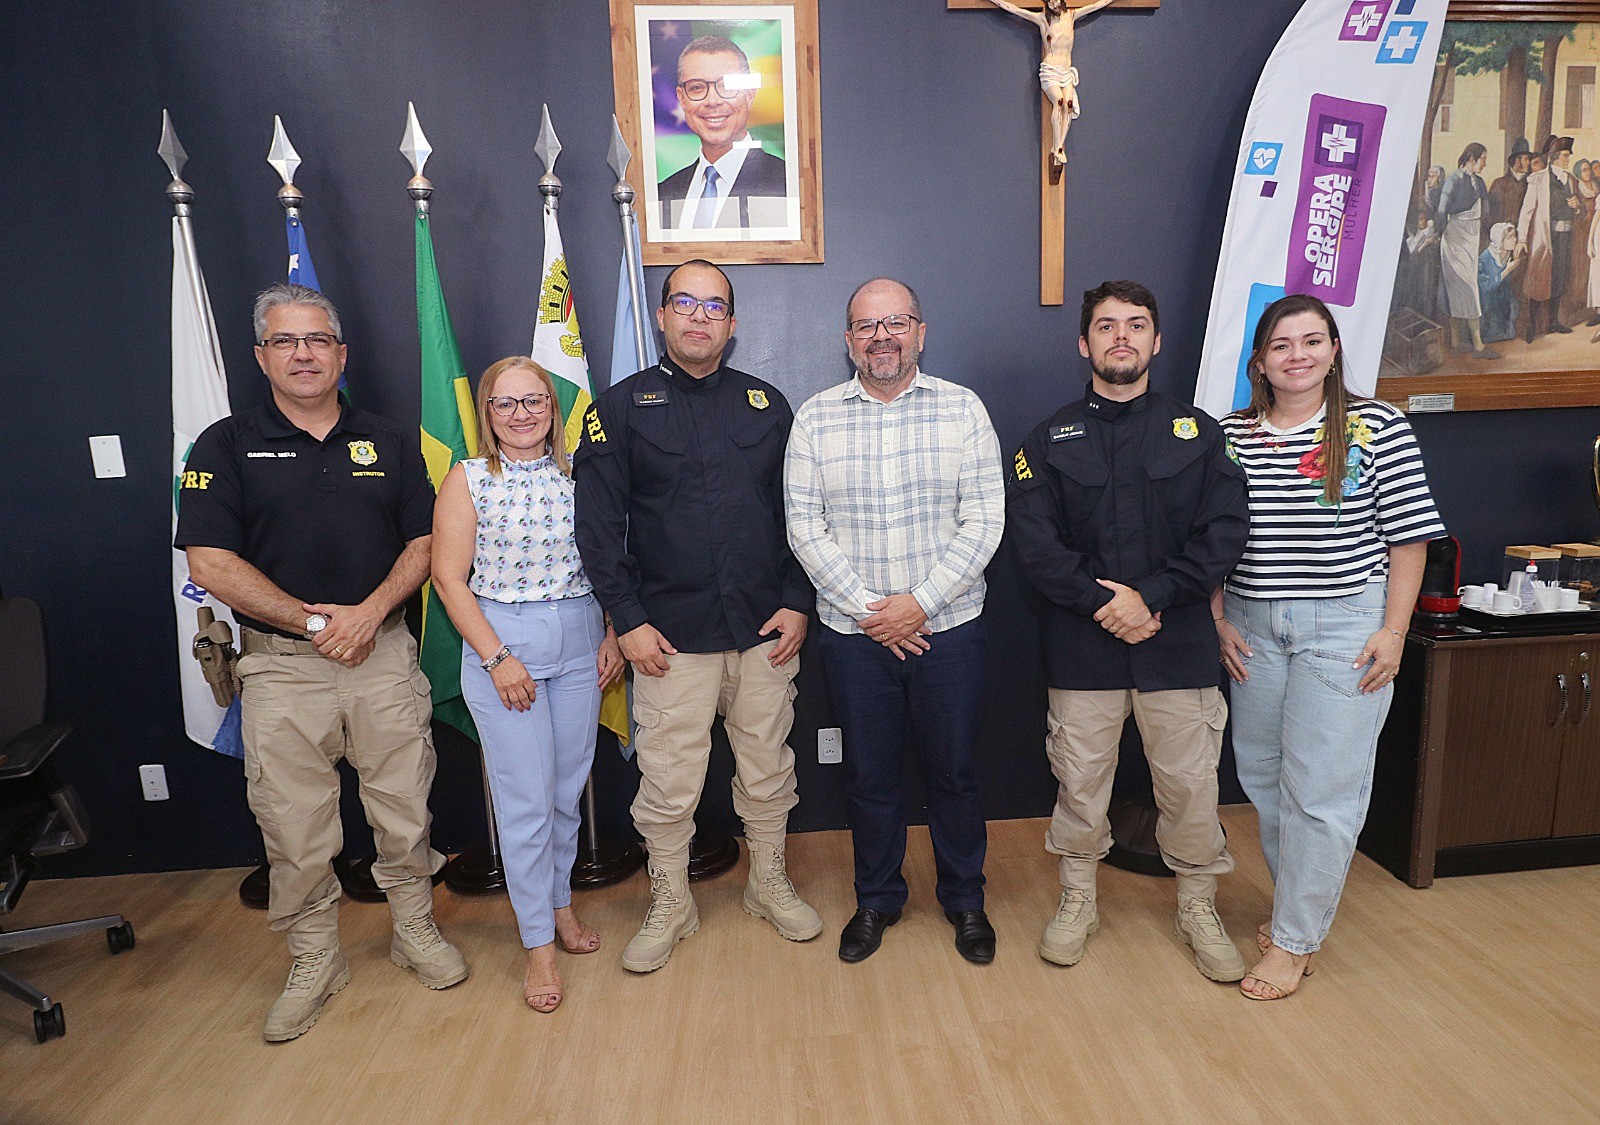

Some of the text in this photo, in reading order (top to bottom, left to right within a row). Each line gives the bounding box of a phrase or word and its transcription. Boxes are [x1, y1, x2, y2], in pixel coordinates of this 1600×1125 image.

[1304, 173, 1334, 263] OPERA
[1312, 173, 1352, 287] SERGIPE
[1344, 178, 1362, 240] MULHER
[586, 407, 607, 443] PRF
[1014, 447, 1034, 481] PRF
